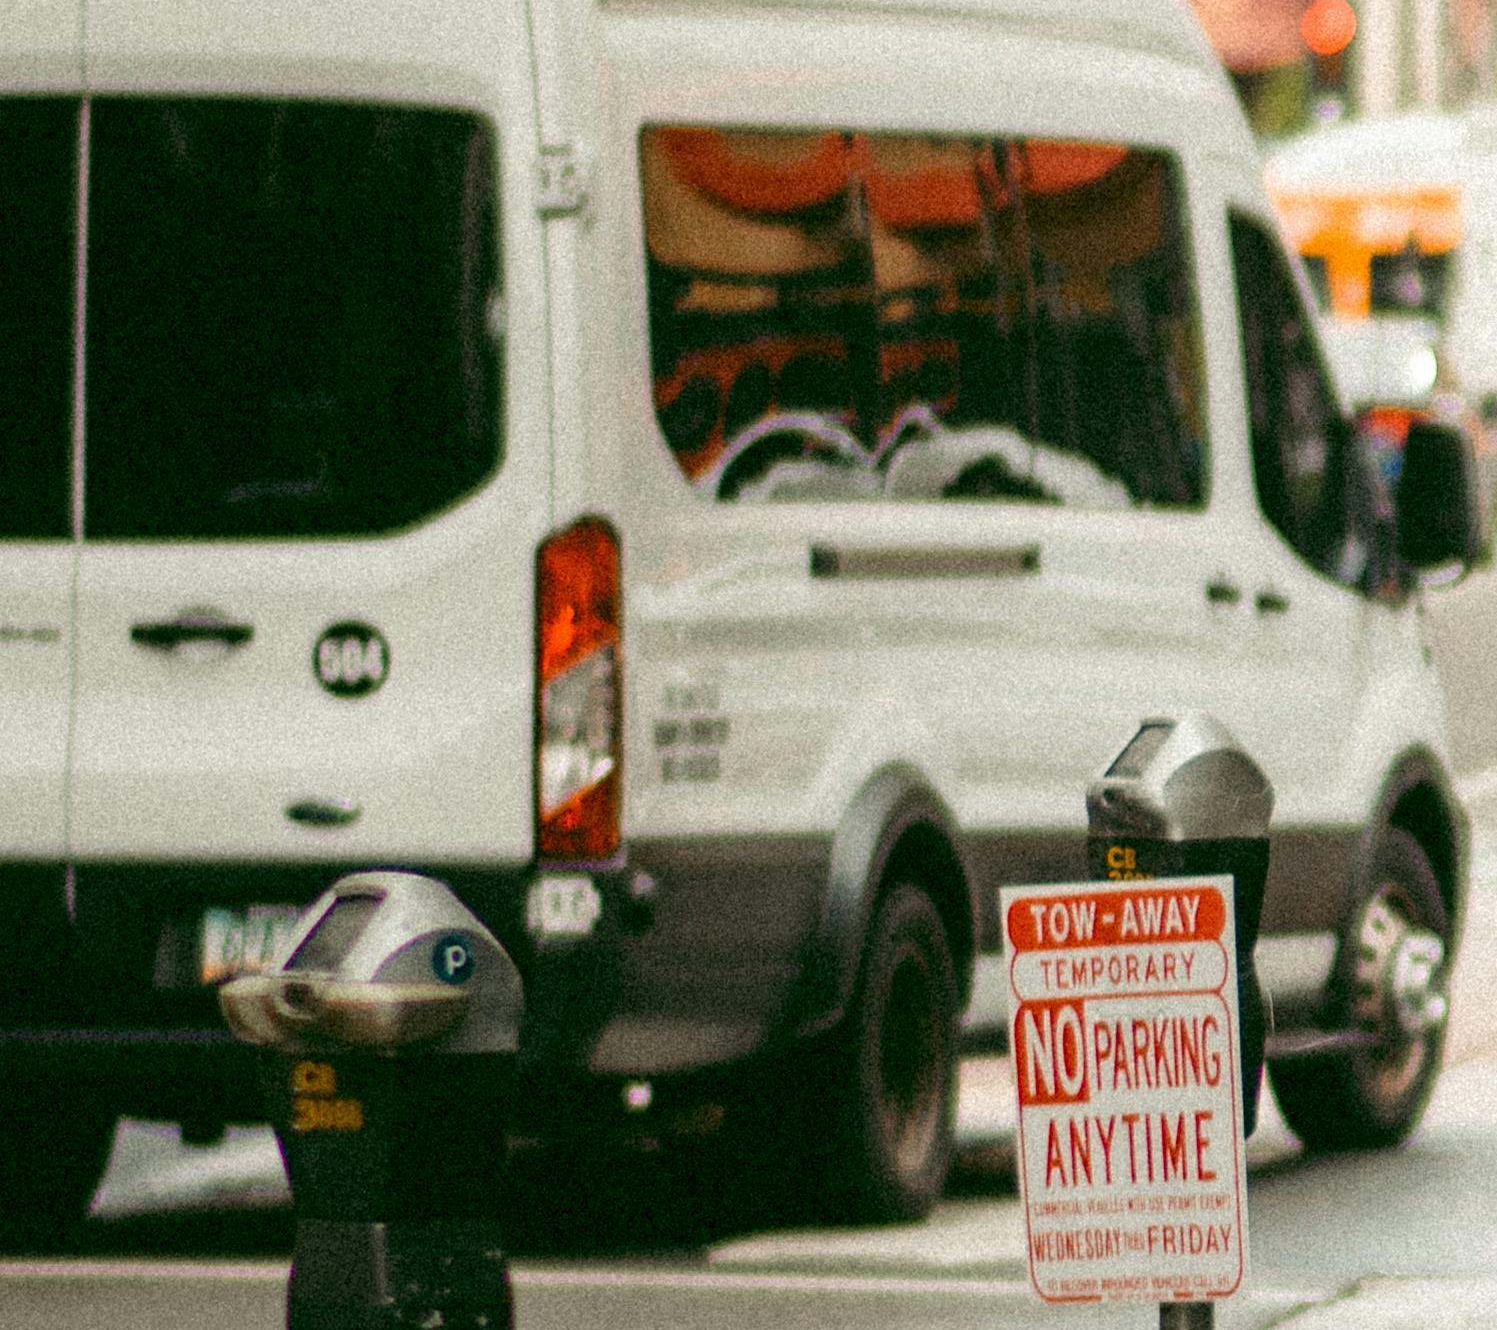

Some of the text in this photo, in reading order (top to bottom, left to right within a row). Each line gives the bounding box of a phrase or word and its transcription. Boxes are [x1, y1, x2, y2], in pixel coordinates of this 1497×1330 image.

[319, 636, 381, 683] 504
[446, 944, 467, 976] P
[1040, 950, 1195, 990] TEMPORARY
[1024, 1005, 1221, 1098] NO PARKING
[1045, 1109, 1217, 1188] ANYTIME
[1034, 1226, 1121, 1262] WEDNESDAY
[1148, 1222, 1232, 1256] FRIDAY
